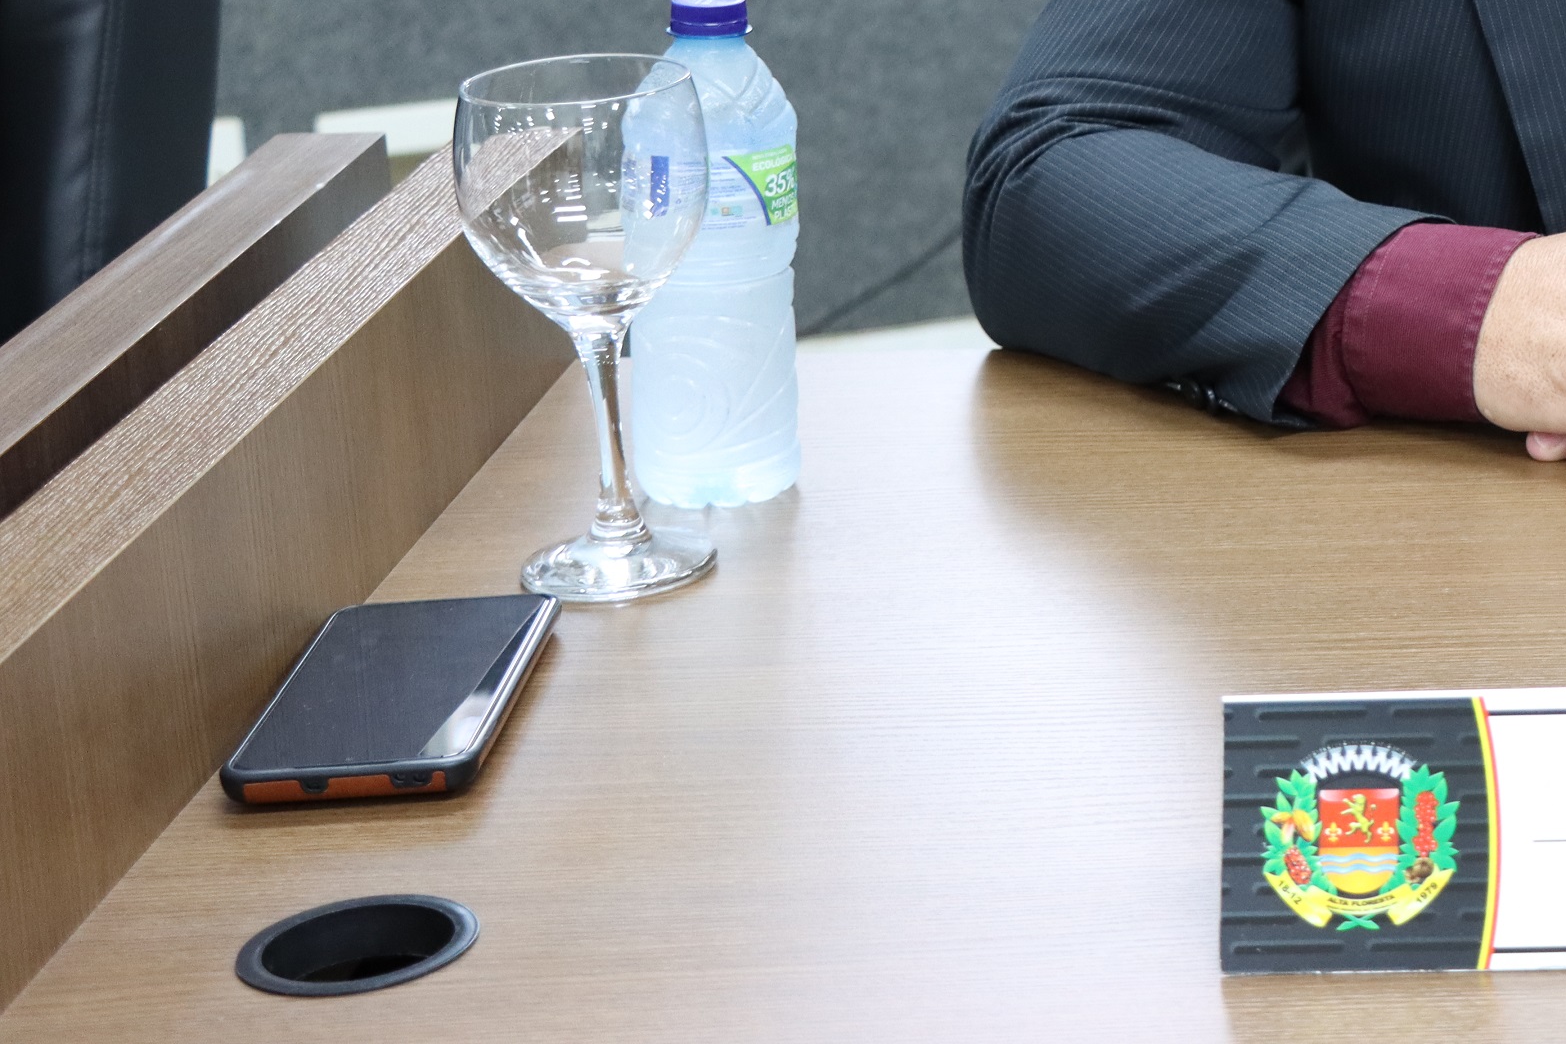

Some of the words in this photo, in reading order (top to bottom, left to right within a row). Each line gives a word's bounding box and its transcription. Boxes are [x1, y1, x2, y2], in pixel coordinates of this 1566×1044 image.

[1327, 897, 1348, 906] ALTA
[1351, 894, 1396, 907] FLORESTA
[1416, 882, 1438, 903] 1979
